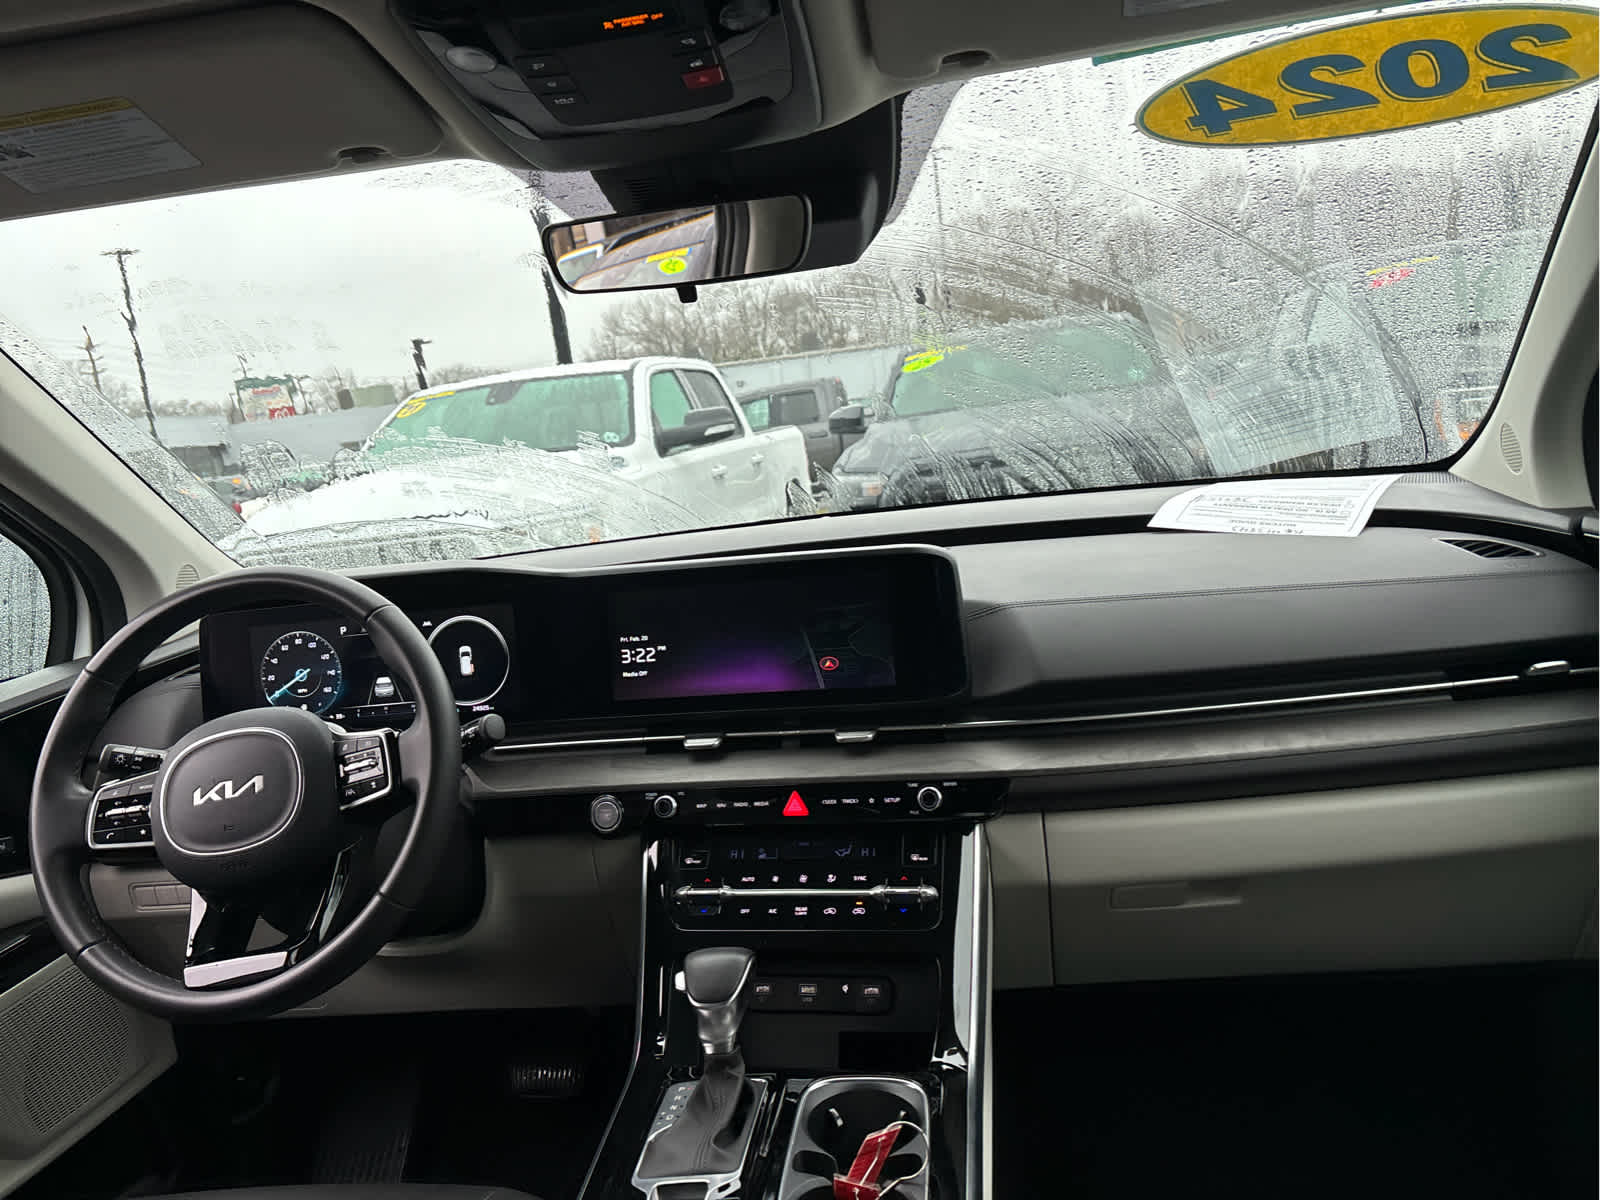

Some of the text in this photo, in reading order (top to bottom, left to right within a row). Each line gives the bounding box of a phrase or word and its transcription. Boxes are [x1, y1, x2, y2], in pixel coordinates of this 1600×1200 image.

[340, 626, 347, 635] P
[620, 647, 657, 664] 3:22
[193, 775, 265, 807] KIA
